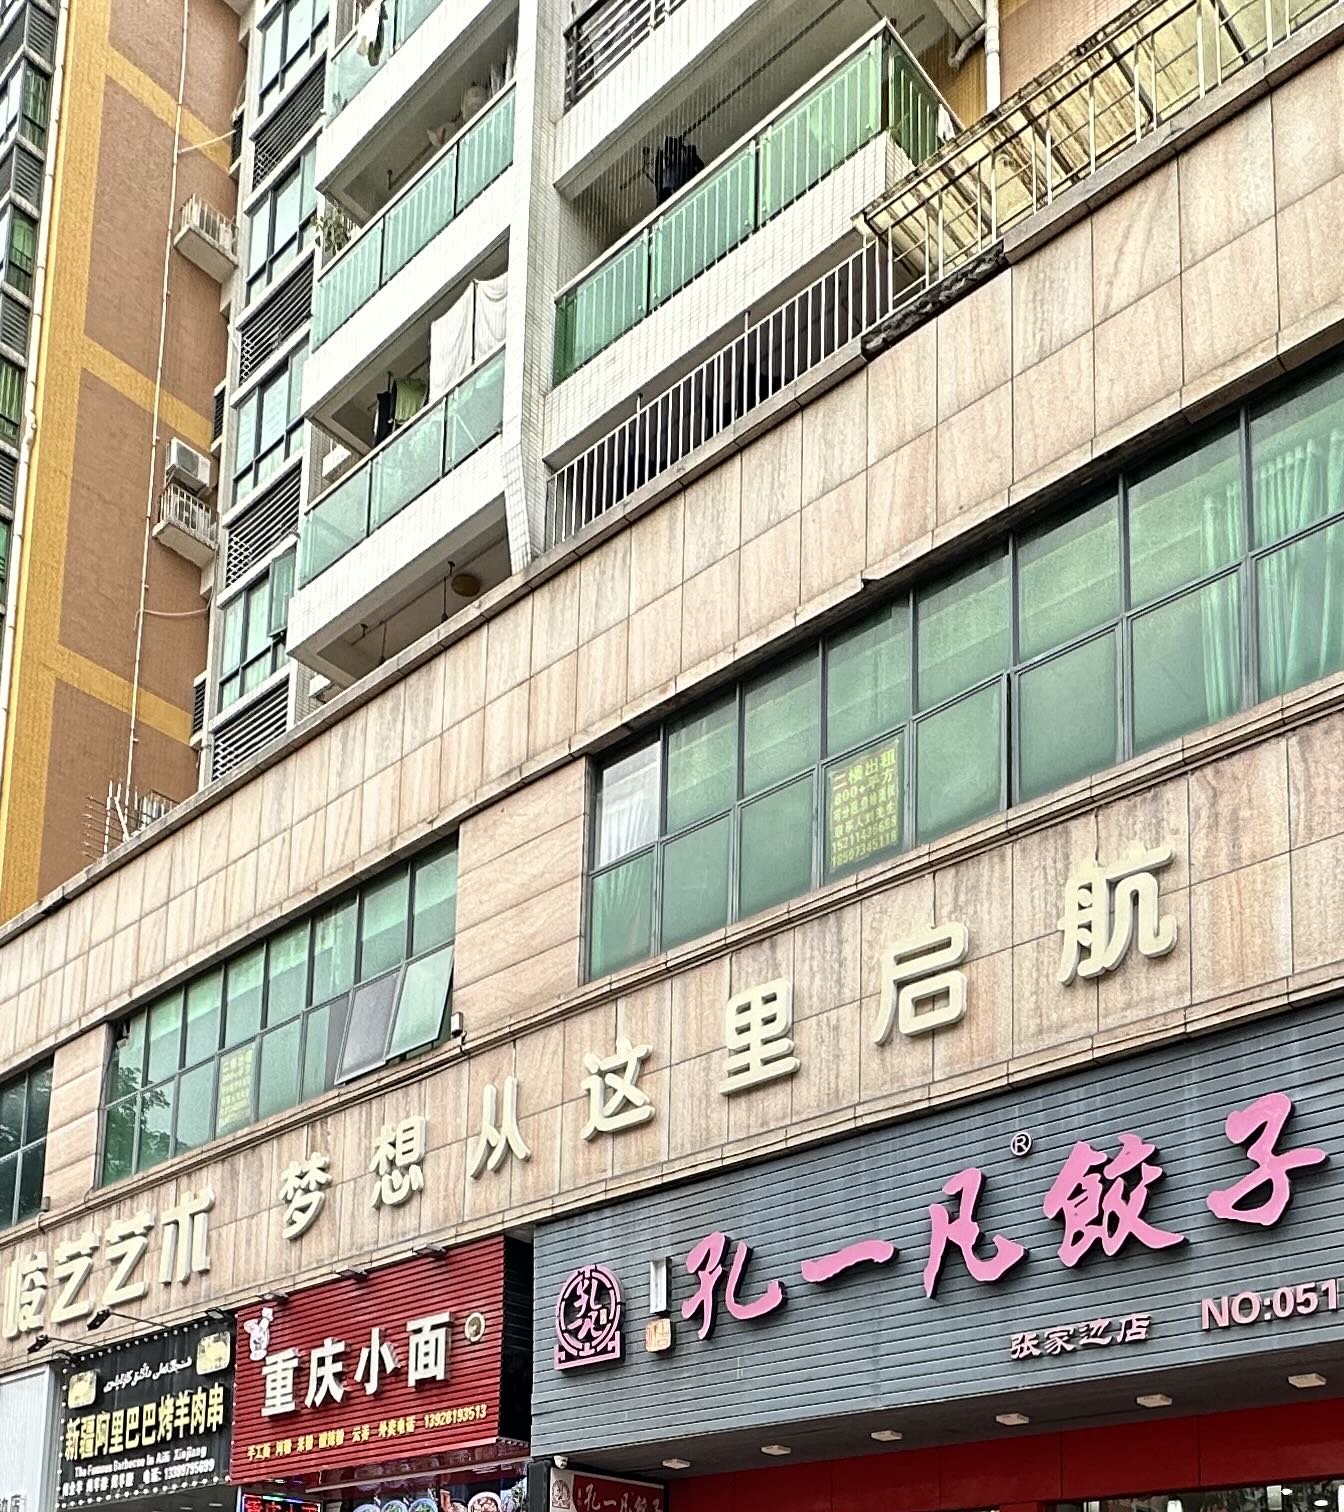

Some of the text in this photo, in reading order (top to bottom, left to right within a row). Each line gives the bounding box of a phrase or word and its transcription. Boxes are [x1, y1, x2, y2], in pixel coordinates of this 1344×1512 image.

[1201, 1278, 1340, 1330] NO:051
[261, 1311, 453, 1418] 重庆小面
[64, 1383, 225, 1463] 新疆阿里巴巴烤羊肉串
